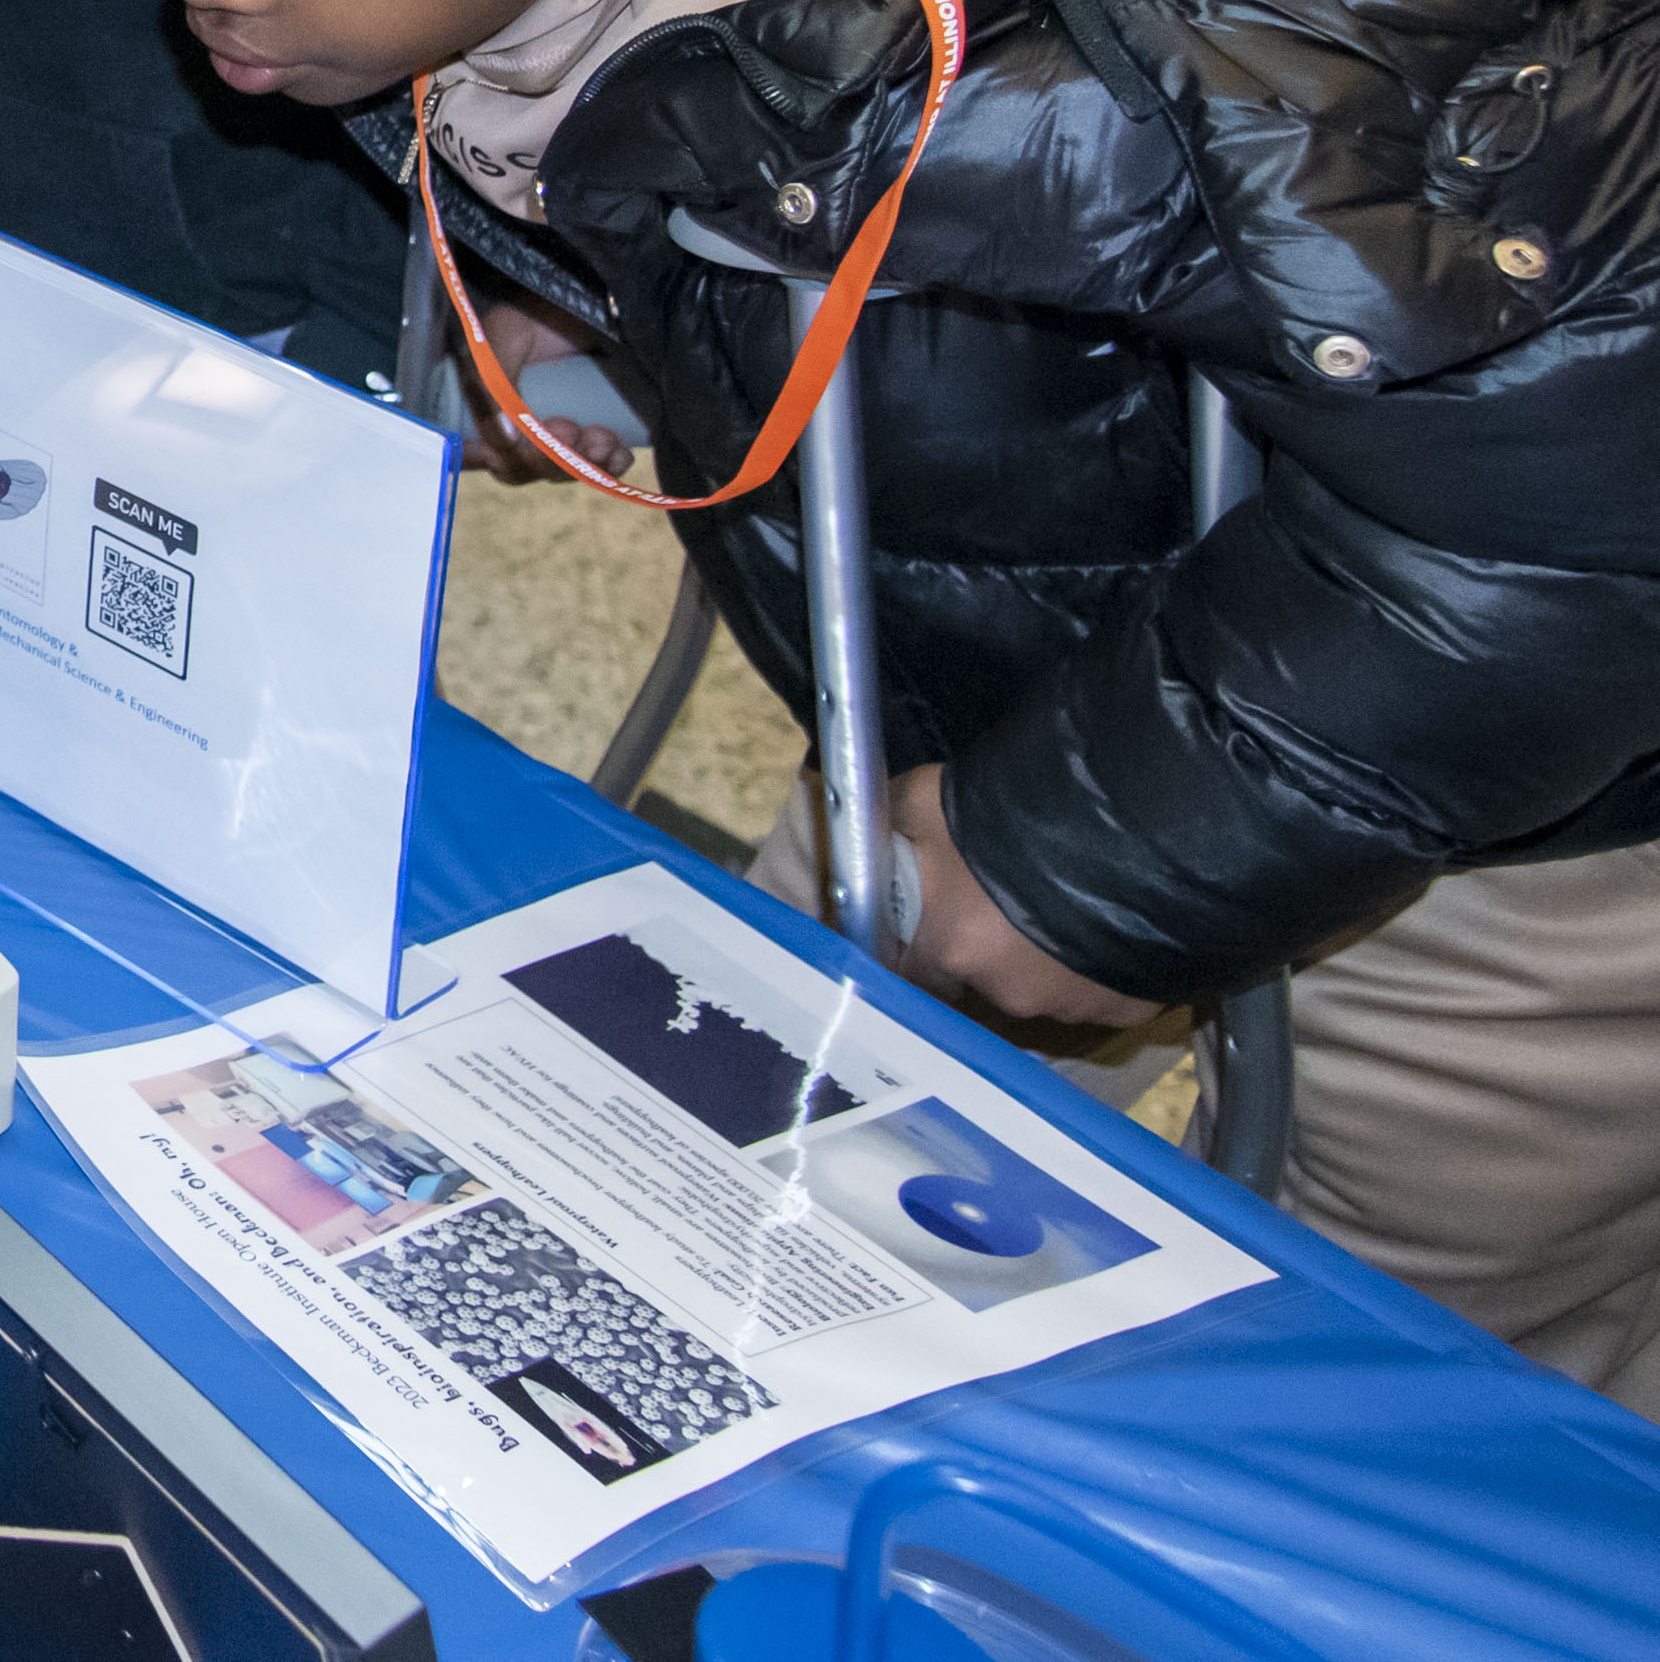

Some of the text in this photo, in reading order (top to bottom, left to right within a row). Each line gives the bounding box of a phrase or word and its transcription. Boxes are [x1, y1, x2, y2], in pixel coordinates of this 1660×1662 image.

[518, 413, 618, 488] ENGINEERING
[108, 491, 184, 542] SCAN ME
[68, 643, 79, 657] &
[64, 660, 112, 697] Science
[115, 689, 126, 703] &
[130, 697, 209, 751] Engineering
[497, 1043, 537, 1070] HVAC
[470, 1067, 494, 1082] that
[491, 1067, 519, 1086] them
[469, 1094, 493, 1111] they
[517, 1086, 548, 1106] make
[491, 1111, 516, 1127] how
[544, 1106, 569, 1121] and
[590, 1111, 617, 1127] and
[138, 1130, 179, 1160] my!
[512, 1127, 537, 1142] and
[648, 1137, 675, 1153] and
[168, 1161, 209, 1191] Oh,
[627, 1164, 649, 1178] the
[656, 1157, 722, 1202] Waterproof
[470, 1141, 620, 1248] Waterproof Leafhoppers
[709, 1181, 737, 1197] and
[603, 1190, 663, 1231] leafhopper
[206, 1190, 291, 1258] Beckman:
[682, 1217, 705, 1231] are
[660, 1232, 696, 1255] study
[787, 1236, 838, 1269] vehicles
[810, 1236, 848, 1262] There
[280, 1257, 328, 1286] and
[692, 1254, 713, 1267] To
[777, 1257, 805, 1275] and
[845, 1261, 878, 1283] Fact:
[673, 1254, 746, 1307] Leafhoppers
[709, 1267, 747, 1291] Goal:
[798, 1257, 876, 1311] Engineering
[167, 1188, 431, 1408] 2023 Beckman Institute Open House
[777, 1284, 831, 1322] Biology:
[876, 1282, 905, 1302] Fun
